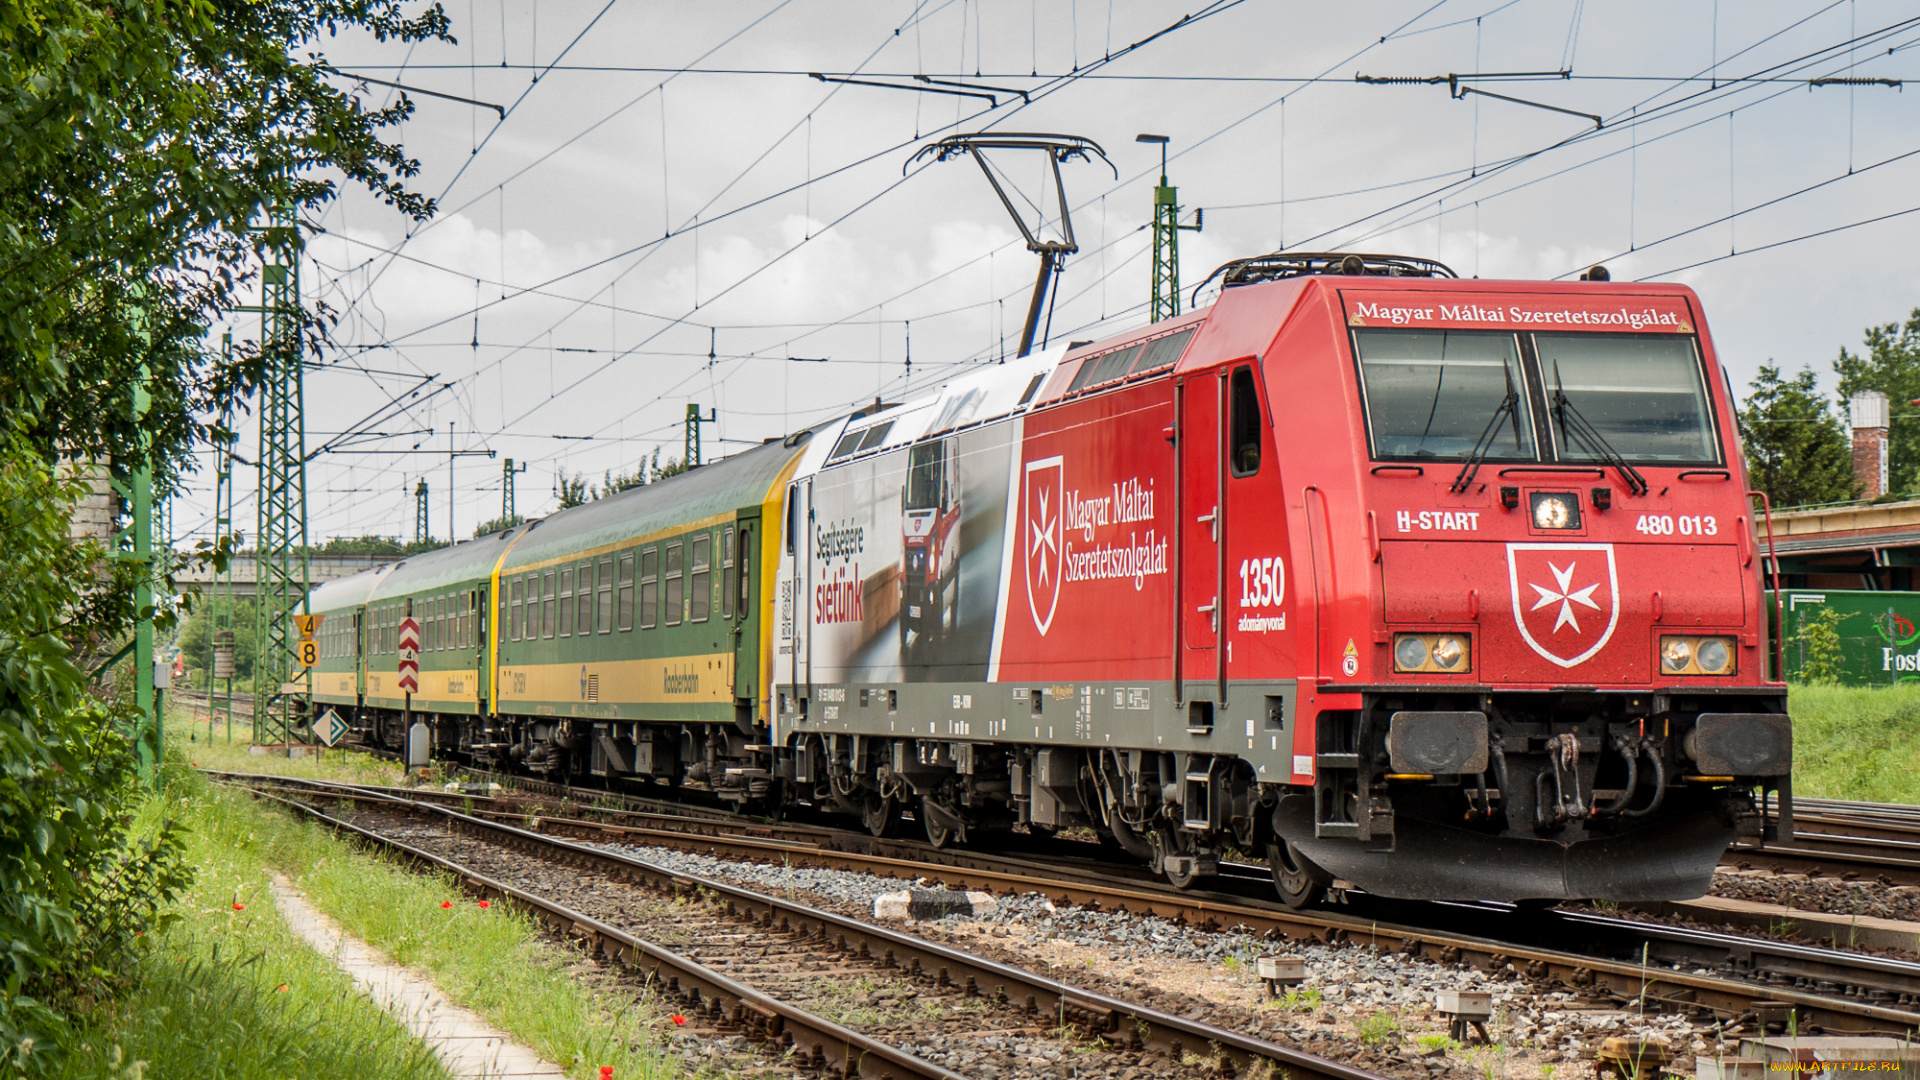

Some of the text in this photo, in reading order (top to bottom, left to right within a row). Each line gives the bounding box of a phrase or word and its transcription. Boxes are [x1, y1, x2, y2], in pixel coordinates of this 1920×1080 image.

[1357, 302, 1679, 329] Magyar Máltai Szeretetszolgálat
[1065, 476, 1155, 543] Magyar Máltai
[1396, 511, 1480, 532] H-START
[1636, 515, 1718, 536] 480 013
[816, 517, 864, 567] Segítségére
[1065, 529, 1168, 592] Szeretetszolgálat
[816, 562, 864, 625] sietünk
[1239, 556, 1285, 608] 1350
[305, 616, 314, 635] 4
[1238, 611, 1286, 635] adományvonal
[303, 643, 316, 664] 8
[406, 650, 412, 660] 4
[1227, 641, 1233, 663] 1
[664, 662, 699, 694] Raaberbahn
